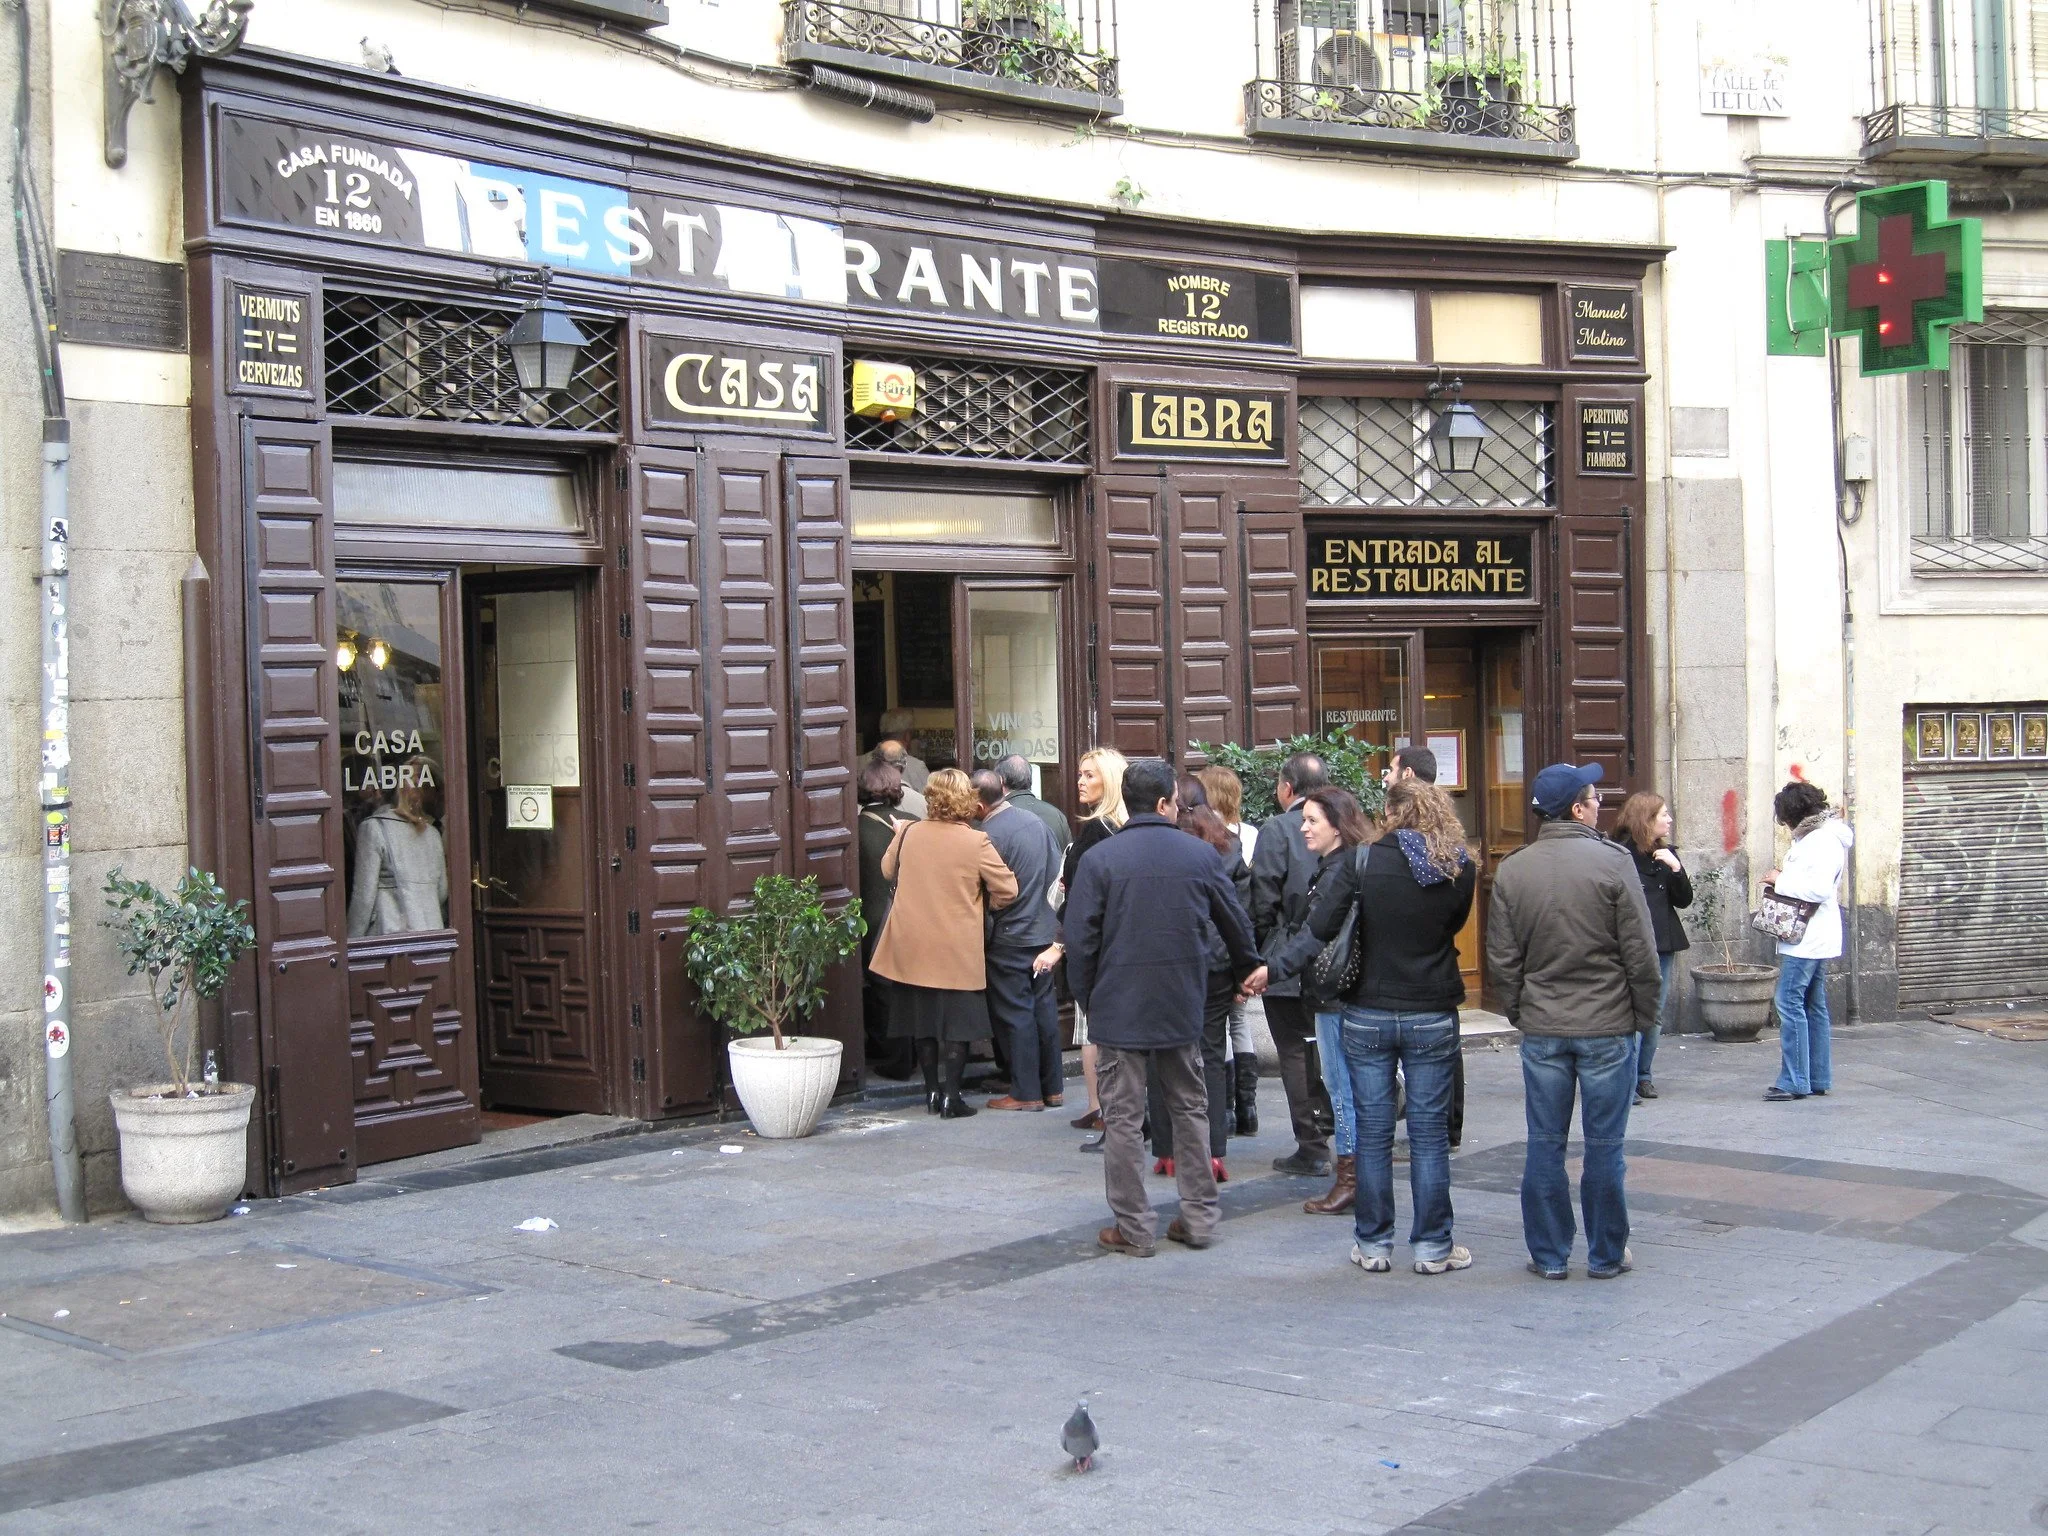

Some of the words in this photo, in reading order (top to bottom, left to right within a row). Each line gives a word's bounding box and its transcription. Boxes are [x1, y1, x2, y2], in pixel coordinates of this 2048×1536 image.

[1712, 74, 1758, 91] CALLE
[1763, 79, 1780, 90] DE
[1709, 91, 1783, 111] TETUAN
[277, 145, 328, 178] CASA
[331, 144, 413, 201] FUNDADA
[323, 169, 372, 209] 12
[315, 206, 340, 228] EN
[344, 210, 382, 234] 1860
[468, 175, 1100, 324] RESTRANTE
[1167, 275, 1231, 297] NOMBRE
[239, 294, 300, 323] VERMUTS
[1184, 292, 1221, 320] 12
[1575, 300, 1628, 319] Manuel
[1158, 318, 1249, 339] REGISTRADO
[1576, 327, 1627, 347] Molina
[239, 360, 303, 388] CERVEZAS
[664, 353, 819, 422] CASA
[1130, 392, 1275, 450] LABRA
[1582, 408, 1629, 424] APERITIVOS
[1586, 451, 1627, 468] FIAMBRES
[1325, 539, 1459, 564] ENTRADA
[1475, 540, 1513, 564] AL
[1312, 568, 1526, 592] RESTAURANTE
[1326, 708, 1397, 723] RESTAURANTE
[354, 729, 425, 755] CASA
[975, 737, 1056, 761] COMDAS
[344, 764, 436, 792] LABRA
